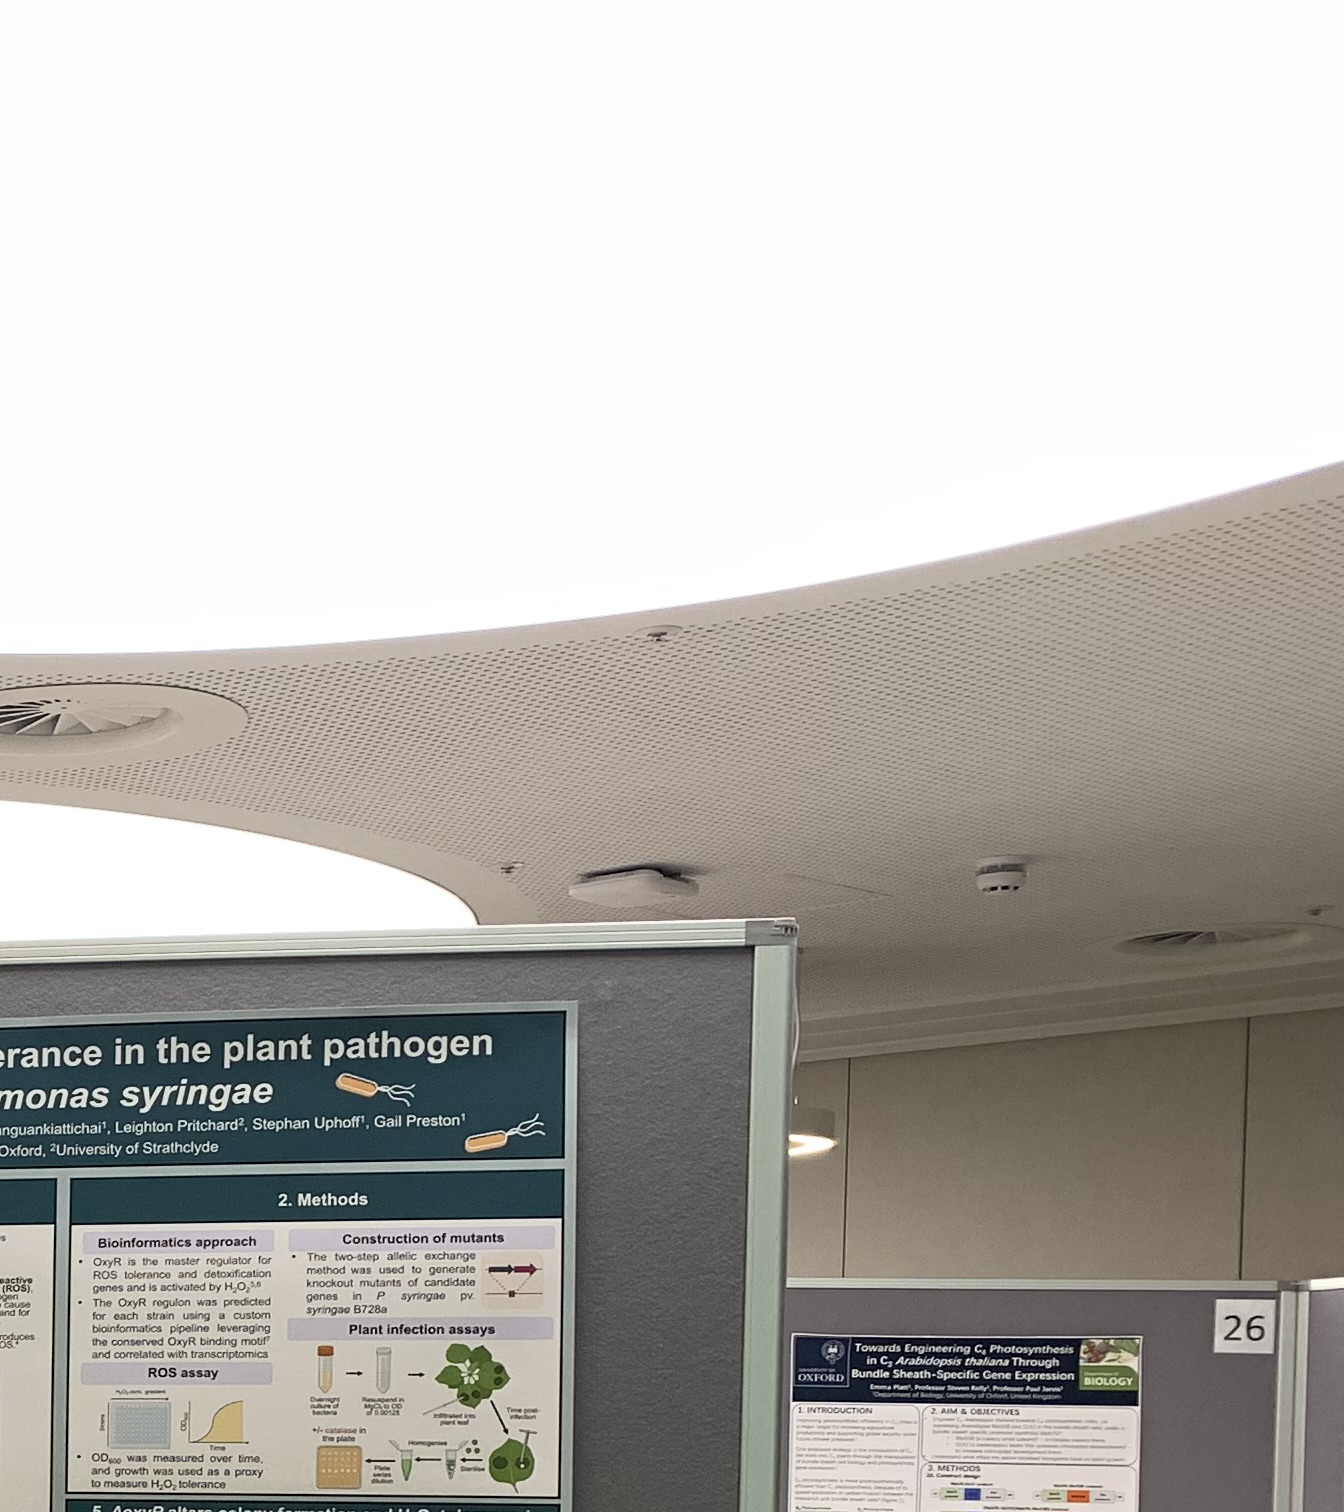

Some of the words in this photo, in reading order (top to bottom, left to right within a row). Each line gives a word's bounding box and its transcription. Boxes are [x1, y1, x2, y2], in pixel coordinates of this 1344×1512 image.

[115, 1038, 144, 1064] in
[156, 1036, 210, 1063] the
[223, 1033, 311, 1068] plant
[324, 1030, 492, 1066] pathogen
[119, 1078, 273, 1113] syringae
[278, 1193, 292, 1206] 2.
[297, 1192, 368, 1206] Methods
[98, 1237, 191, 1248] Bioinformatics
[195, 1236, 256, 1249] approach
[307, 1252, 327, 1261] The
[334, 1252, 379, 1262] two-step
[386, 1251, 417, 1260] allelic
[424, 1251, 476, 1262] exchange
[349, 1324, 383, 1334] Plant
[387, 1323, 444, 1334] infection
[448, 1326, 495, 1337] assays
[1223, 1315, 1266, 1343] 26
[854, 1343, 901, 1352] Towards
[904, 1343, 971, 1355] Engineering
[989, 1344, 1074, 1356] Photosynthesis
[866, 1355, 877, 1364] in
[894, 1356, 962, 1367] Arabidopsis
[964, 1356, 1009, 1366] thaliana
[1011, 1357, 1059, 1369] Through
[798, 1374, 845, 1382] OXFORD
[851, 1369, 889, 1378] Bundle
[892, 1369, 979, 1381] Sheath-Specific
[982, 1370, 1011, 1379] Gene
[1014, 1370, 1074, 1381] Expression
[1084, 1377, 1134, 1387] BIOLOGY
[807, 1406, 872, 1414] INTRODUCTION
[937, 1464, 981, 1472] METHODS
